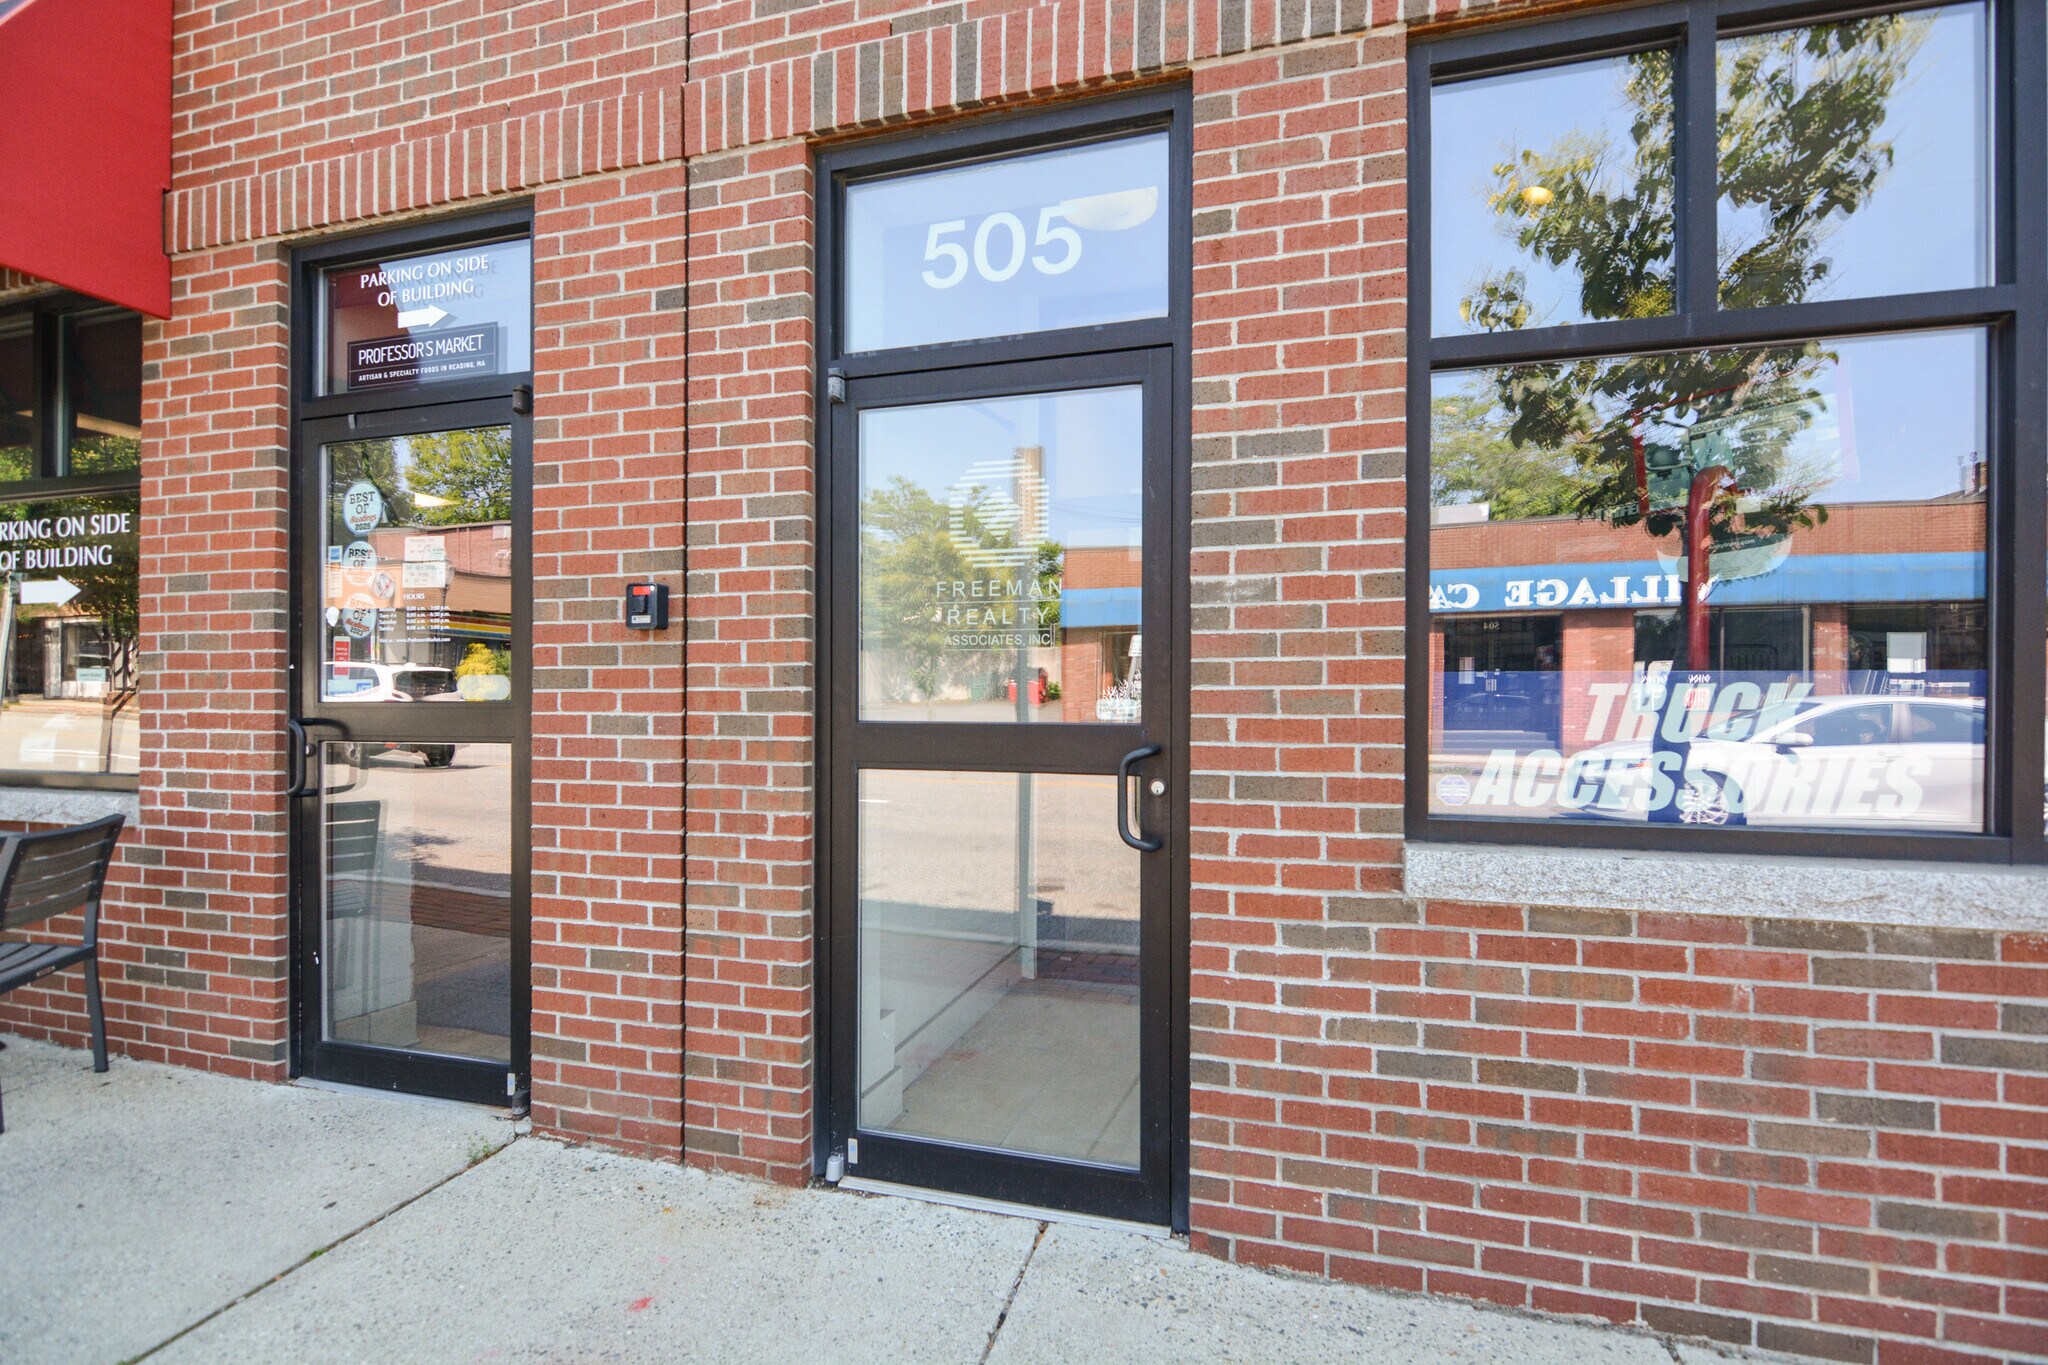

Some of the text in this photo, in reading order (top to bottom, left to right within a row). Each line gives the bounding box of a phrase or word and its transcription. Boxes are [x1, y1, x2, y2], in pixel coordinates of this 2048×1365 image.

[921, 203, 1083, 289] 505
[360, 254, 489, 289] PARKING ON SIDE
[377, 278, 474, 307] OF BUILDING
[358, 333, 485, 366] PROFESSOR'S MARKET
[358, 372, 383, 382] ARTISAN
[383, 371, 389, 379] &
[389, 368, 420, 379] SPECIALTY
[420, 365, 440, 374] FOODS
[448, 361, 476, 371] READING,
[476, 360, 486, 368] MA
[349, 491, 376, 505] BEST
[355, 503, 370, 515] OF
[55, 516, 85, 538] ON
[90, 512, 131, 536] SIDE
[354, 522, 372, 531] 2025
[0, 544, 113, 571] OF BUILDING
[348, 548, 373, 559] BEST
[353, 559, 367, 569] OF
[935, 578, 1063, 598] FREEMAN
[349, 597, 376, 614] BEST
[352, 609, 366, 622] OF
[946, 606, 1051, 626] REALTY
[943, 632, 1054, 647] ASSOCIATES, INC.
[1582, 681, 1814, 744] TRUCK
[1469, 749, 1930, 822] ACCESSORIES
